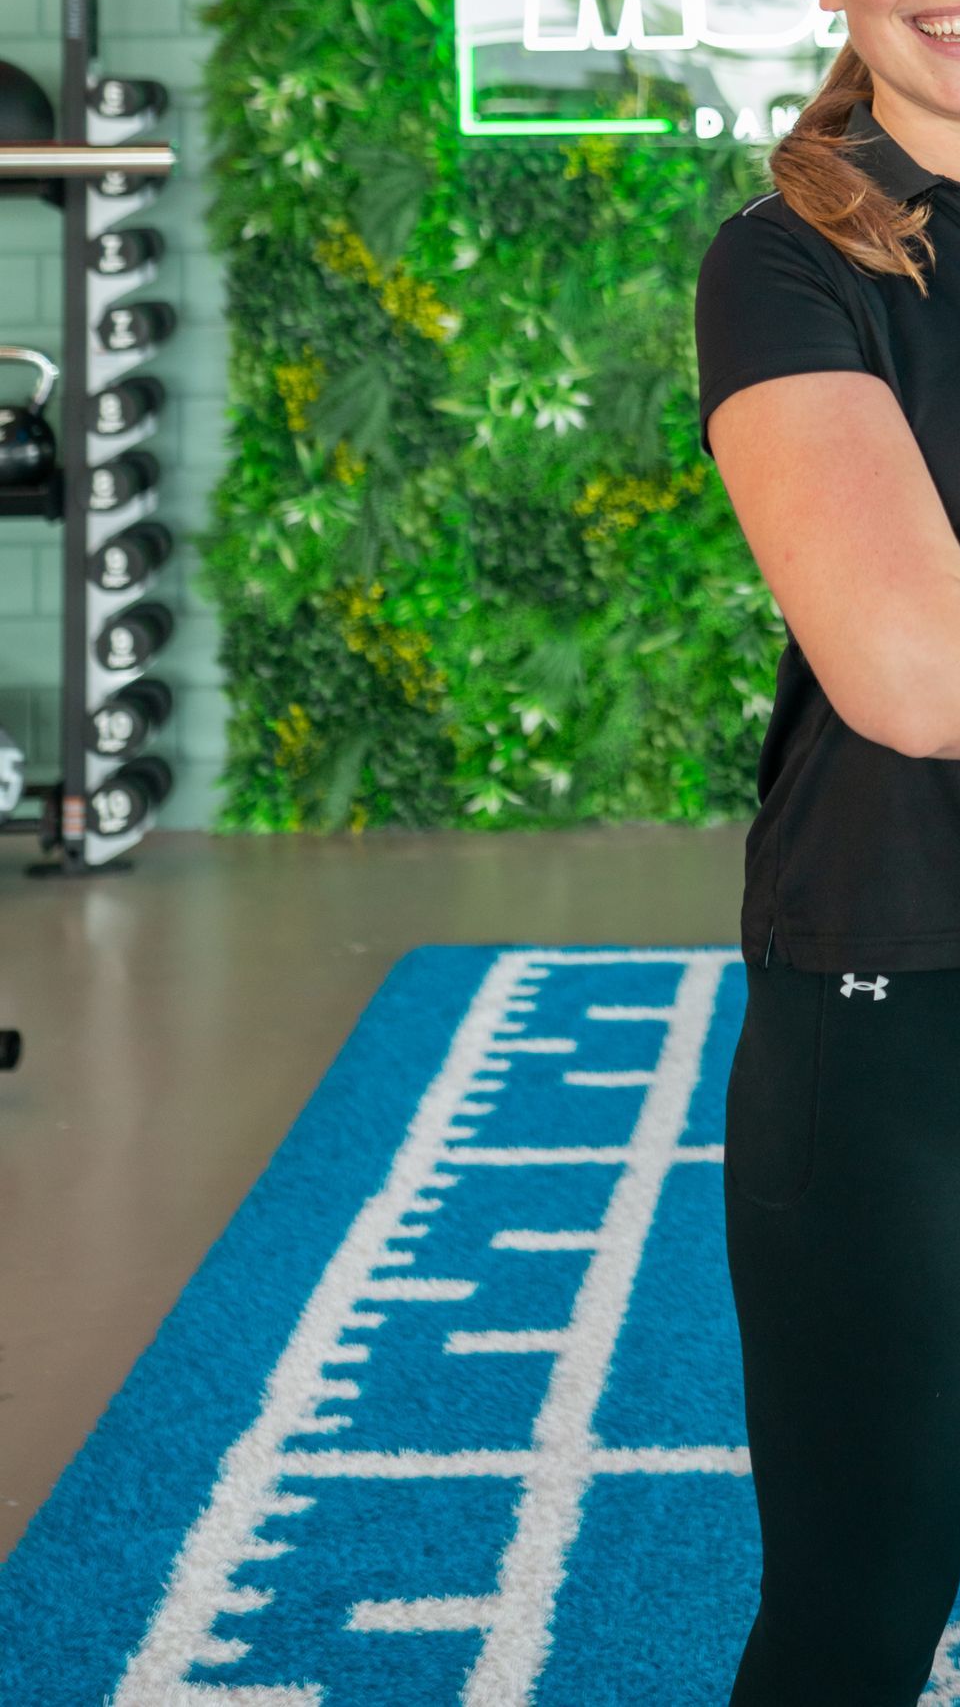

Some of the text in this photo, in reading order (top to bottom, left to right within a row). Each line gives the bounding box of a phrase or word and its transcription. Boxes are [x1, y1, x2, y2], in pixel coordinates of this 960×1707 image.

[695, 106, 804, 140] DAN
[94, 709, 133, 741] 10
[92, 790, 131, 820] 10
